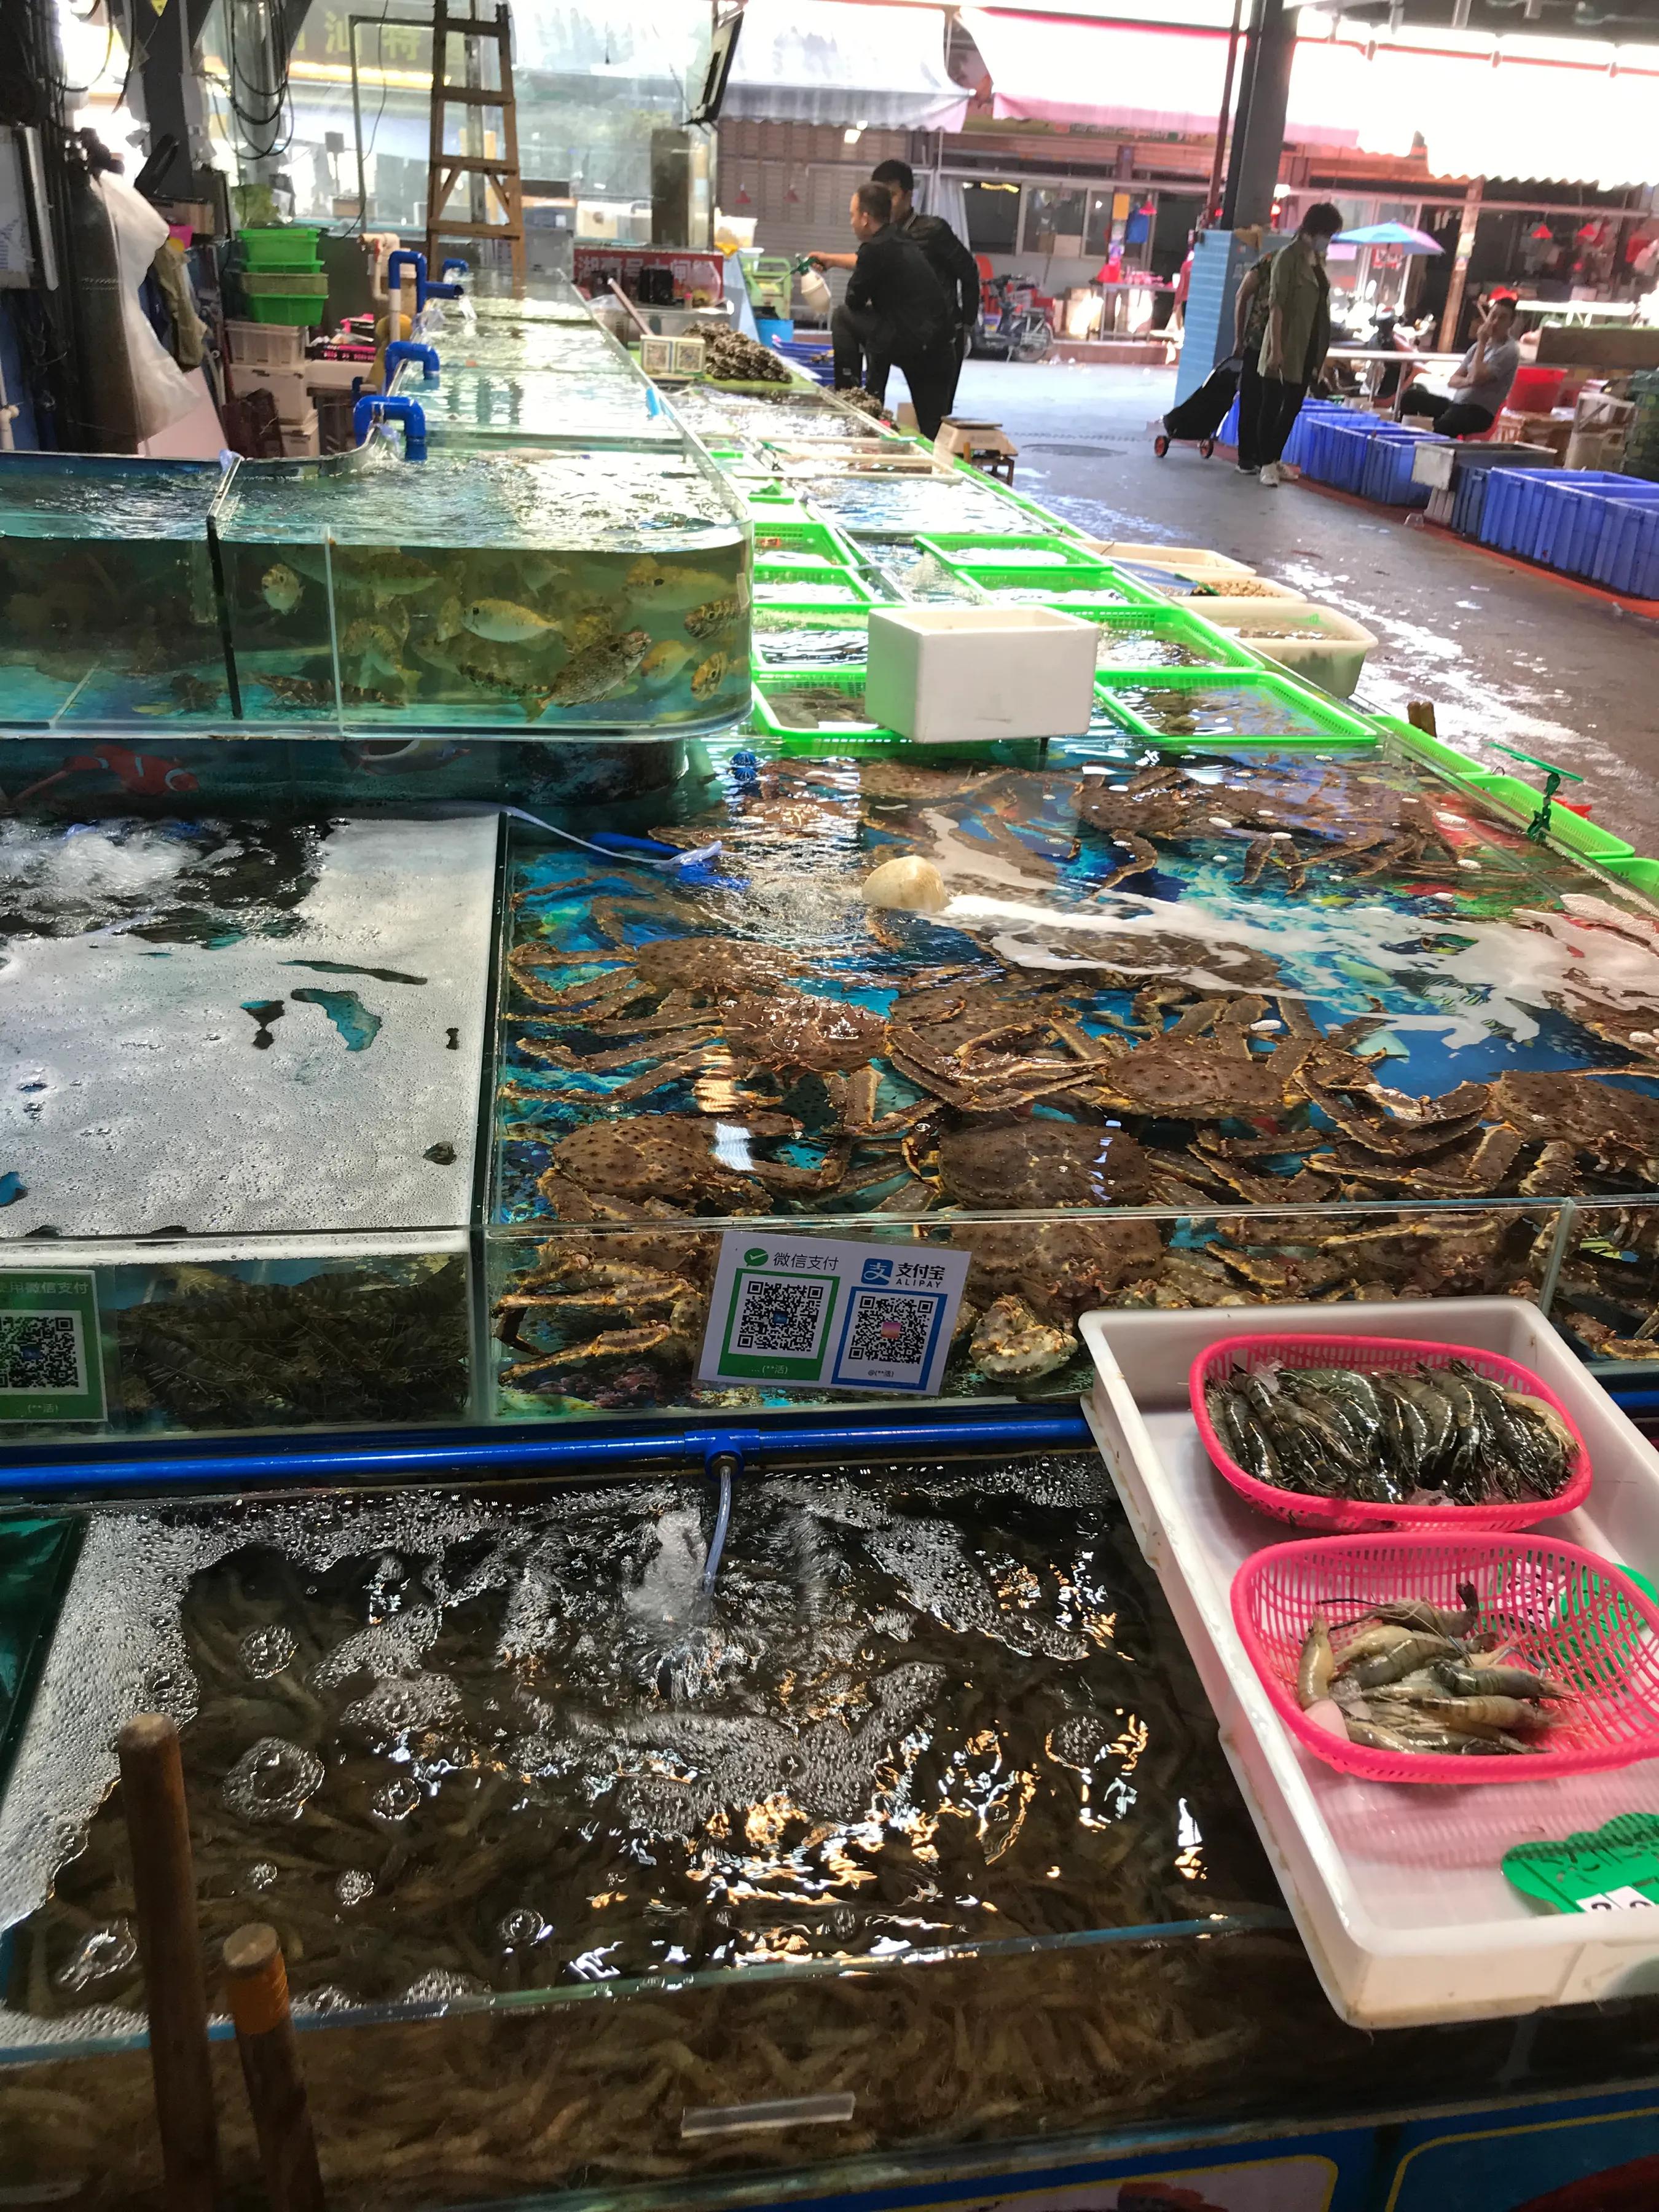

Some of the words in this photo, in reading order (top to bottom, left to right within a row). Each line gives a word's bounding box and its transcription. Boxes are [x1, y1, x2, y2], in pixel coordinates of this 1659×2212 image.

[774, 1252, 839, 1271] 微信支付
[896, 1263, 945, 1280] 支付宝
[896, 1279, 941, 1288] ALIPAY
